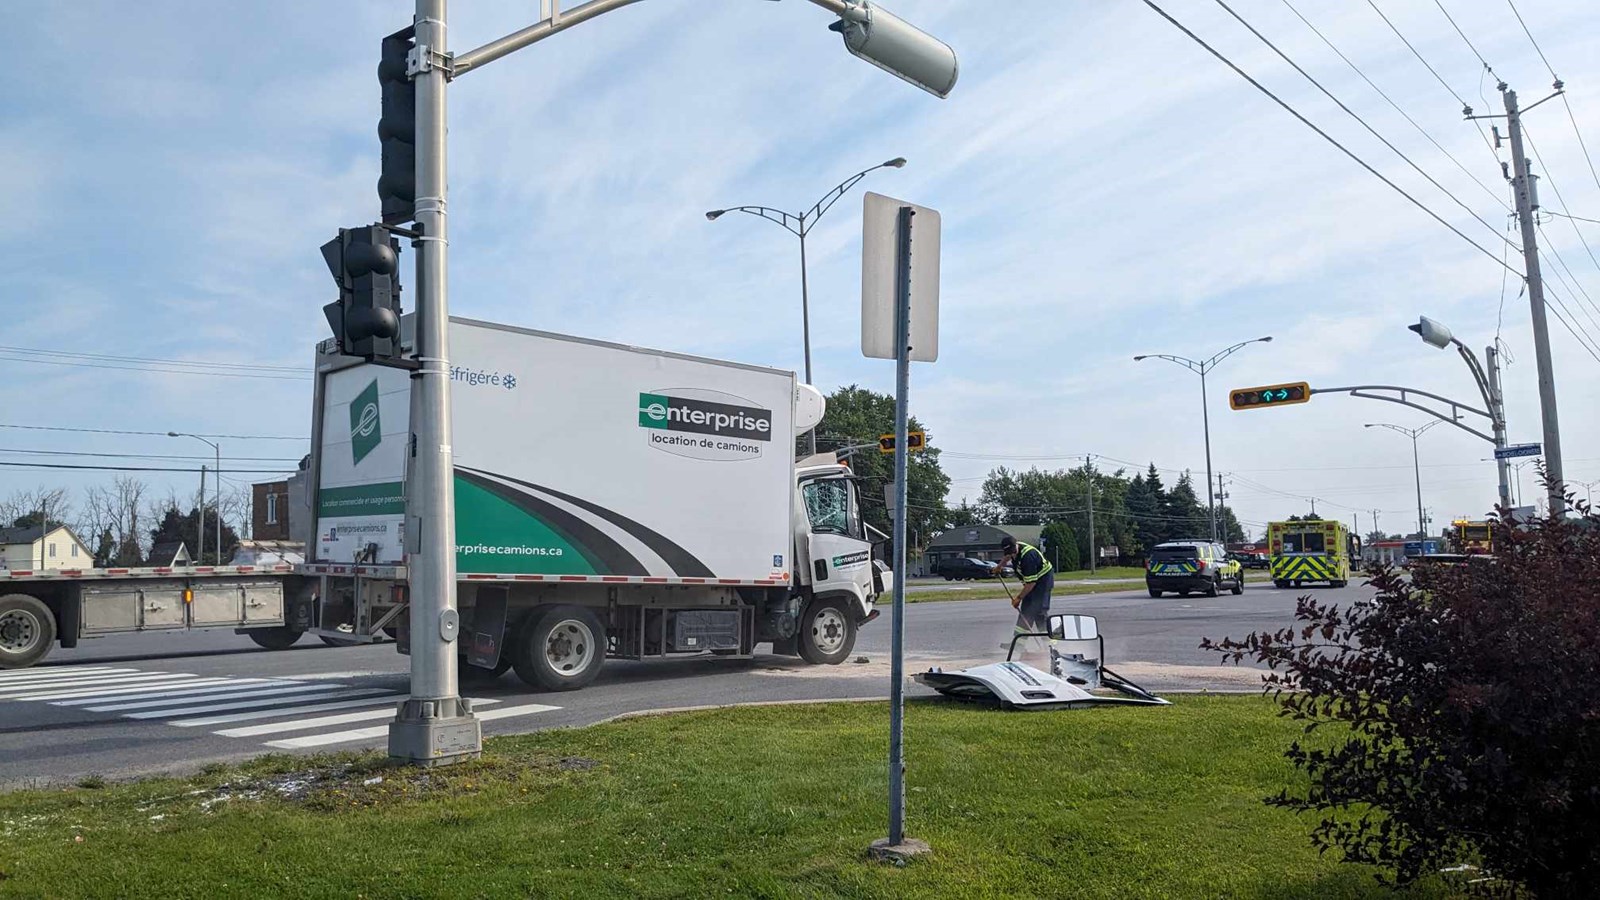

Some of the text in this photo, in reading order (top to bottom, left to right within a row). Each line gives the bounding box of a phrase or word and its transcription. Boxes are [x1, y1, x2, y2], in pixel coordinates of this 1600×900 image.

[450, 366, 499, 386] éfrigéré
[640, 403, 770, 432] enterprise
[652, 433, 760, 453] location de camions
[455, 543, 563, 556] erprisecamions.ca
[834, 553, 869, 565] enterprise
